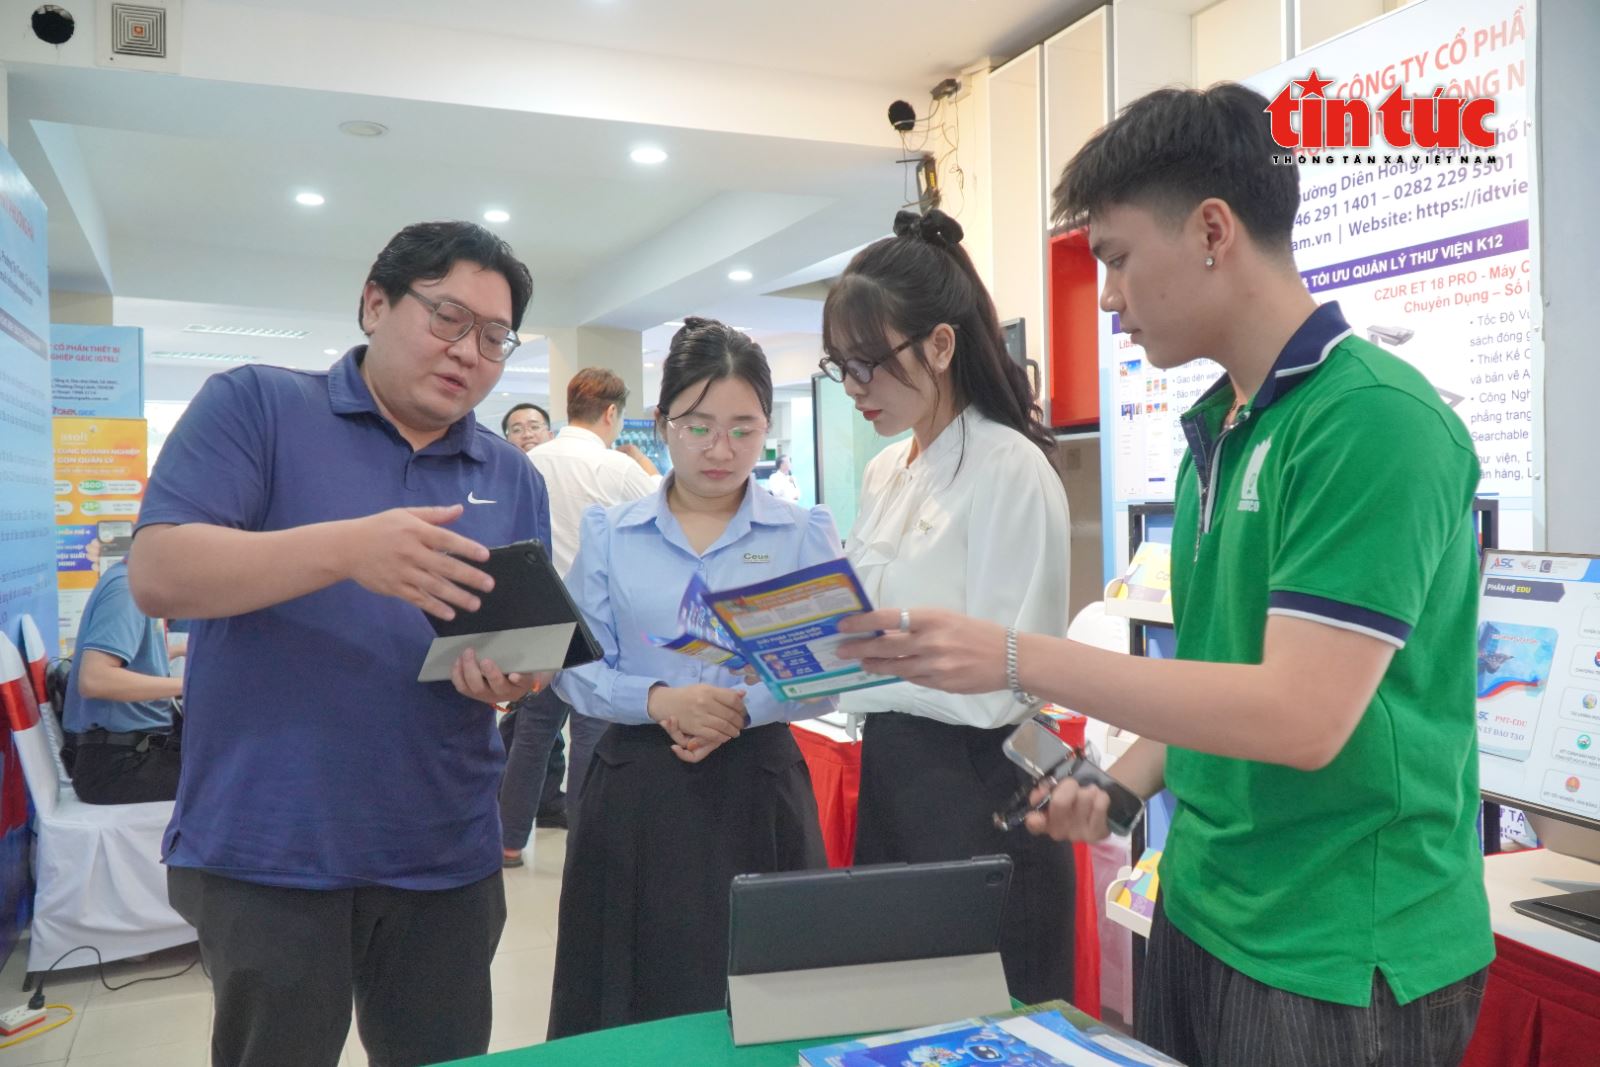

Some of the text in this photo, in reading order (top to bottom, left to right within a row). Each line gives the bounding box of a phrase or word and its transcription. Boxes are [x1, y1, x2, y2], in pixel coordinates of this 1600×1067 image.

[1401, 51, 1429, 84] TY
[1435, 27, 1468, 70] CỔ
[1314, 203, 1338, 222] 291
[1343, 192, 1377, 214] 1401
[1394, 177, 1433, 200] 0282
[1437, 166, 1467, 189] 229
[1472, 153, 1513, 179] 5501
[1348, 211, 1412, 237] Website:
[1416, 178, 1529, 220] https://idtvie
[1332, 267, 1350, 283] ƯU
[1409, 248, 1439, 266] THƯ
[1440, 240, 1473, 260] VIỆN
[1476, 233, 1504, 252] K12
[1374, 284, 1408, 302] CZUR
[1410, 279, 1427, 294] ET
[1430, 277, 1445, 291] 18
[1448, 270, 1478, 287] PRO
[1489, 264, 1517, 280] Máy
[1403, 295, 1451, 313] Chuyên
[1454, 290, 1489, 307] Dụng
[1504, 278, 1523, 296] Số
[1500, 311, 1515, 323] Độ
[1479, 391, 1506, 404] Công
[1471, 428, 1529, 442] Searchable
[1516, 586, 1532, 594] EDU
